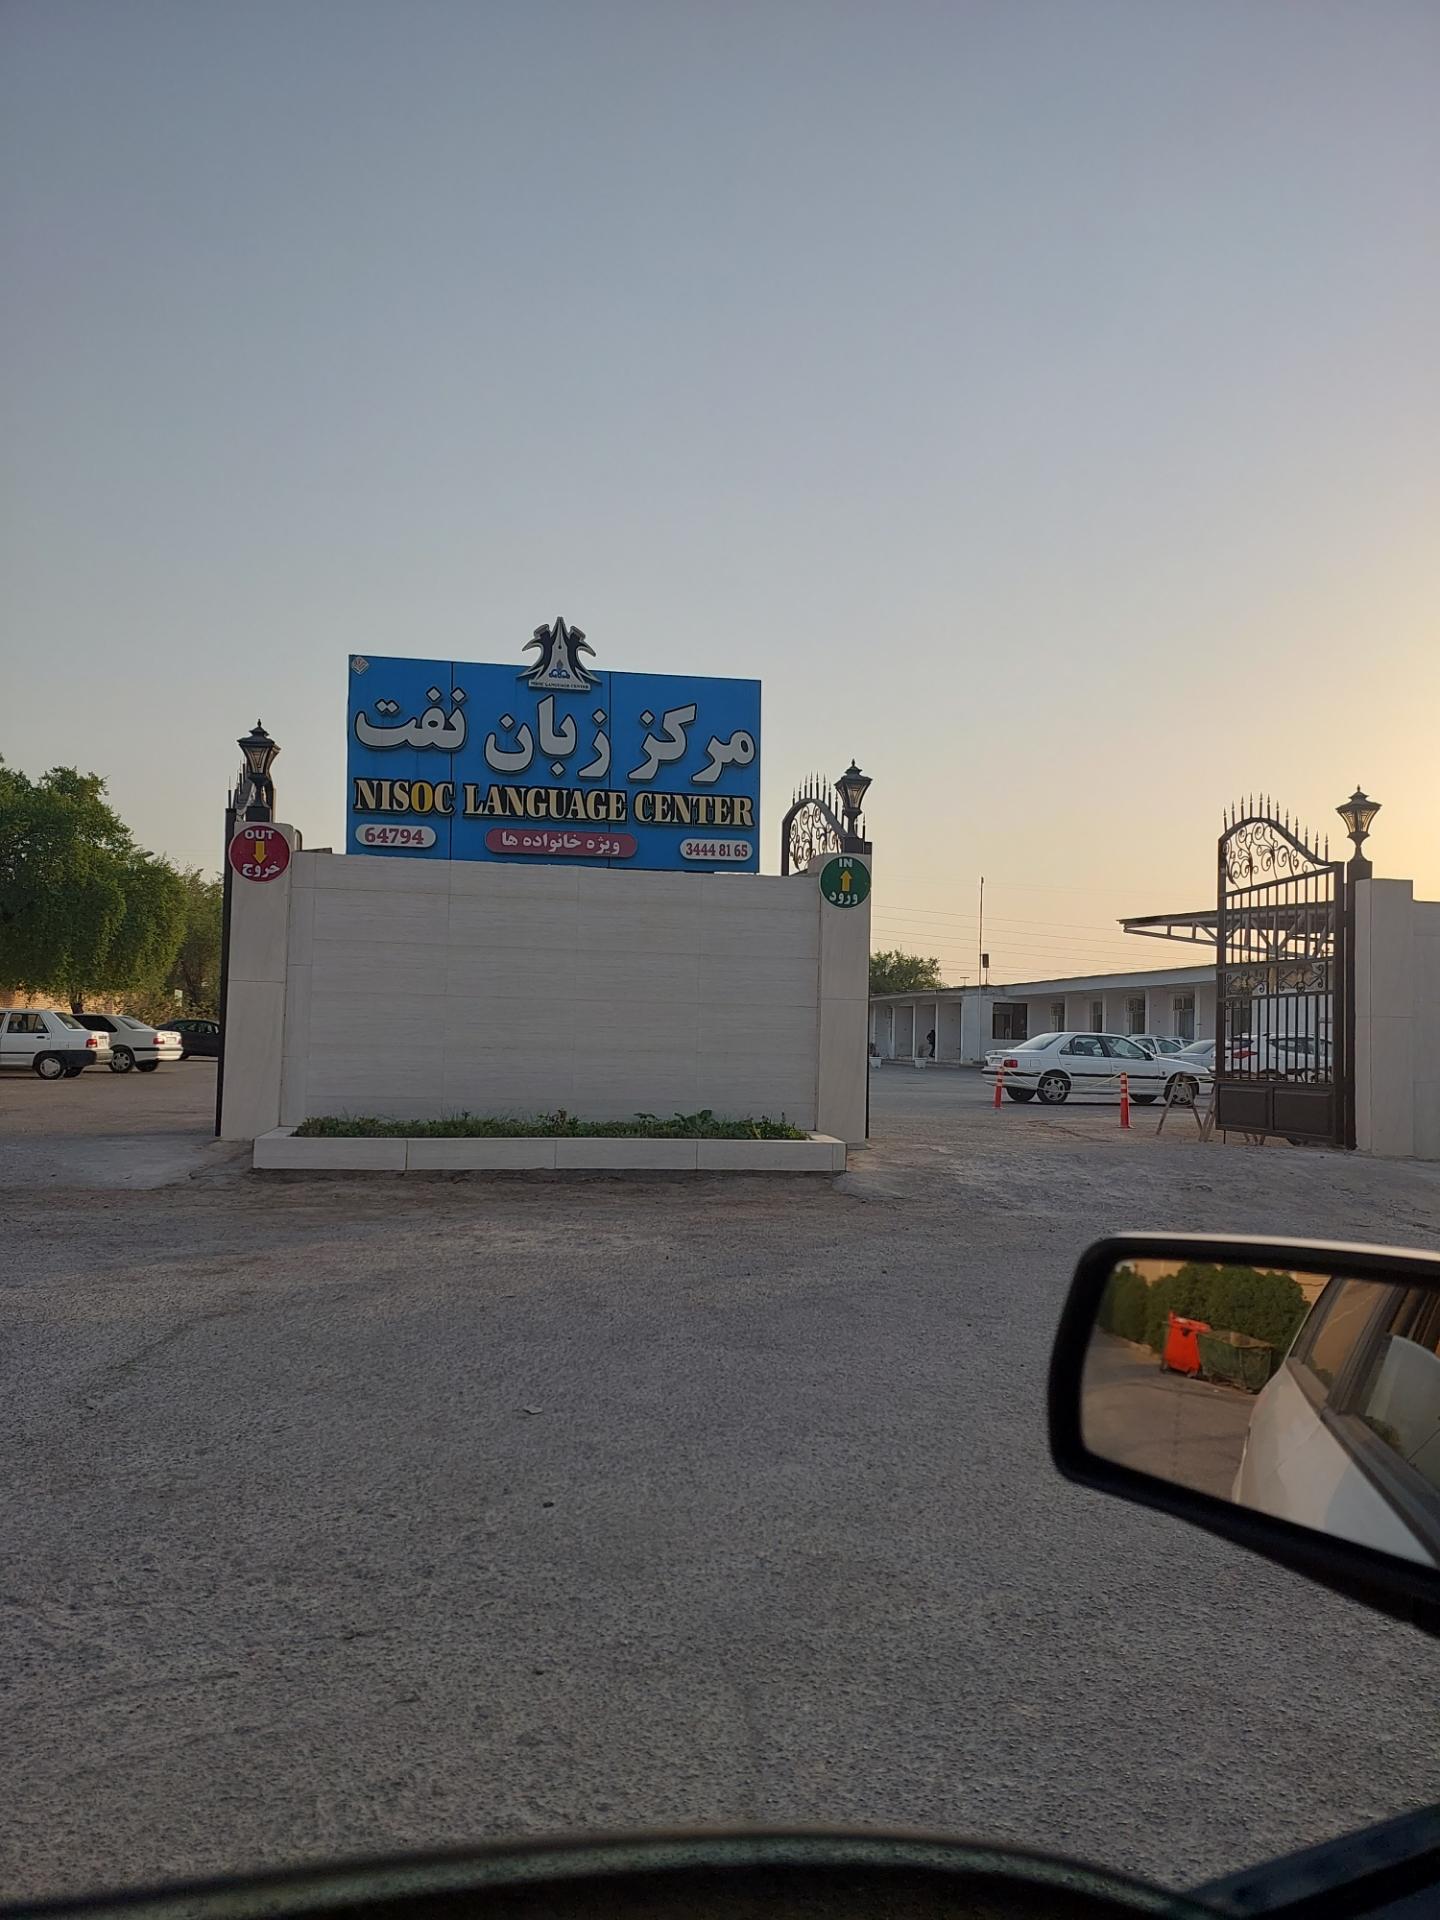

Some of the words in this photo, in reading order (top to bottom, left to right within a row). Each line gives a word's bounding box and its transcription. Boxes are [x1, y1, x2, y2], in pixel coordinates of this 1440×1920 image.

[355, 686, 467, 751] نفت
[485, 694, 612, 780] زبان
[628, 703, 756, 784] مرکز
[354, 778, 455, 814] NISOC
[464, 785, 628, 822] LANGUAGE
[634, 791, 755, 827] CENTER
[245, 830, 274, 839] OUT
[364, 826, 425, 846] 64794
[501, 831, 518, 846] ها
[523, 832, 581, 852] خانواده
[586, 836, 621, 855] ویژه
[686, 842, 716, 856] 3444
[242, 861, 280, 877] خروج
[838, 858, 853, 868] IN
[829, 891, 858, 904] ورود
